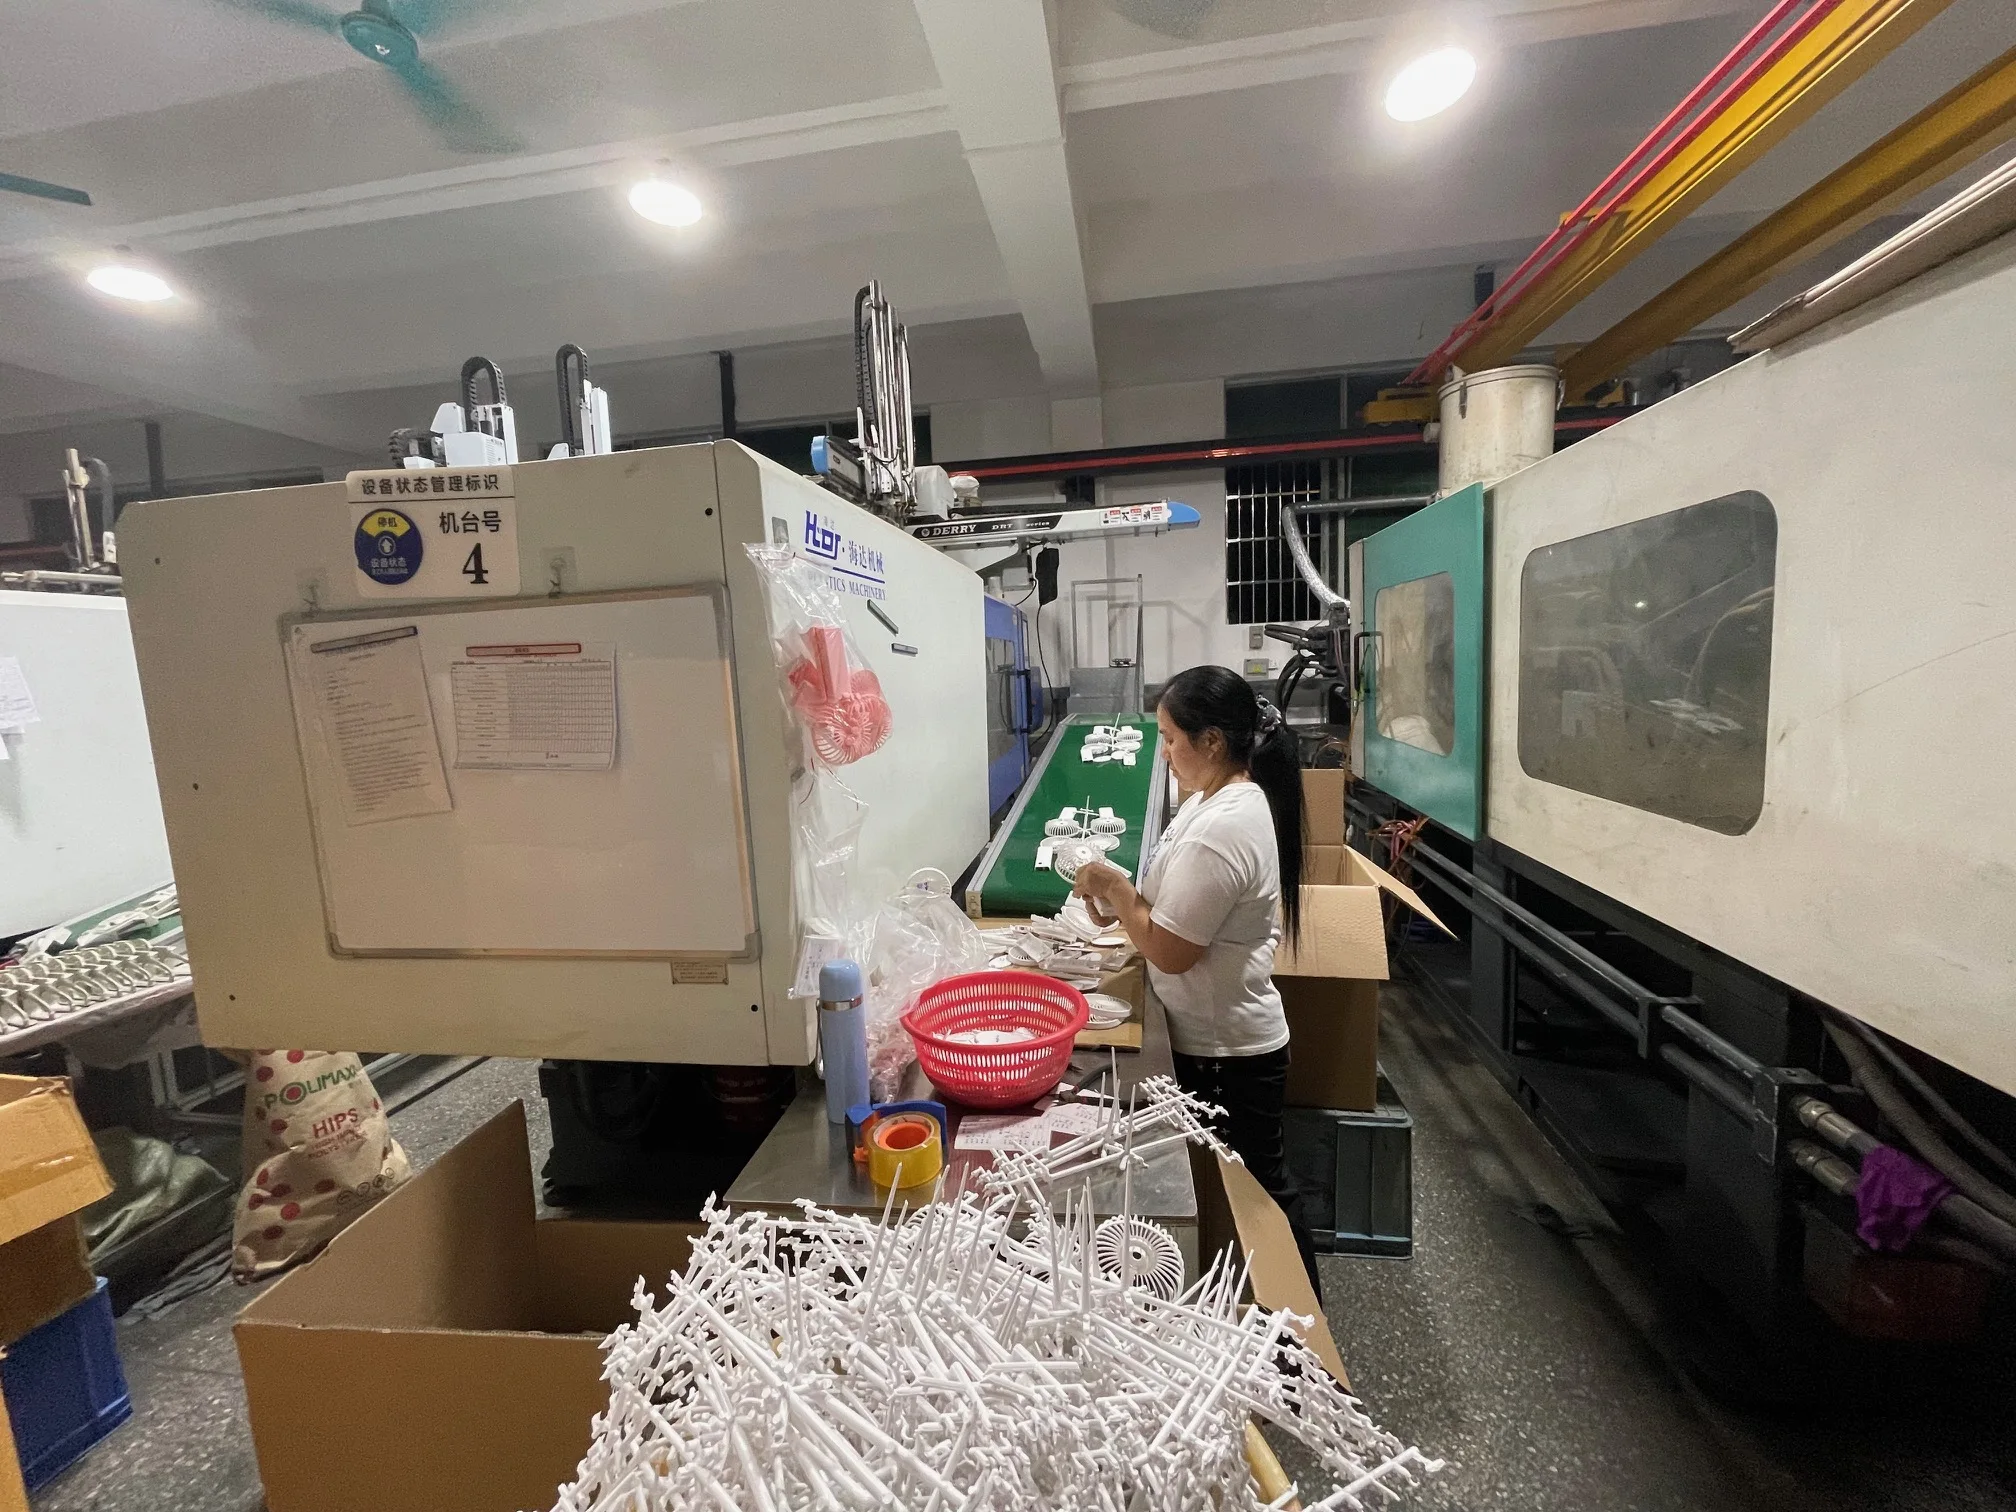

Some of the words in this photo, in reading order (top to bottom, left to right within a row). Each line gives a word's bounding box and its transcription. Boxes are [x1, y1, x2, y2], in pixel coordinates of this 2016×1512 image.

[362, 474, 499, 495] 设备状态管理标识
[439, 511, 502, 534] 机台号
[932, 524, 977, 536] DERRY
[991, 523, 1013, 531] DRT
[462, 542, 488, 584] 4
[849, 580, 886, 601] MACHINERY
[264, 1065, 357, 1109] POLIMAX
[312, 1108, 358, 1138] HIPS
